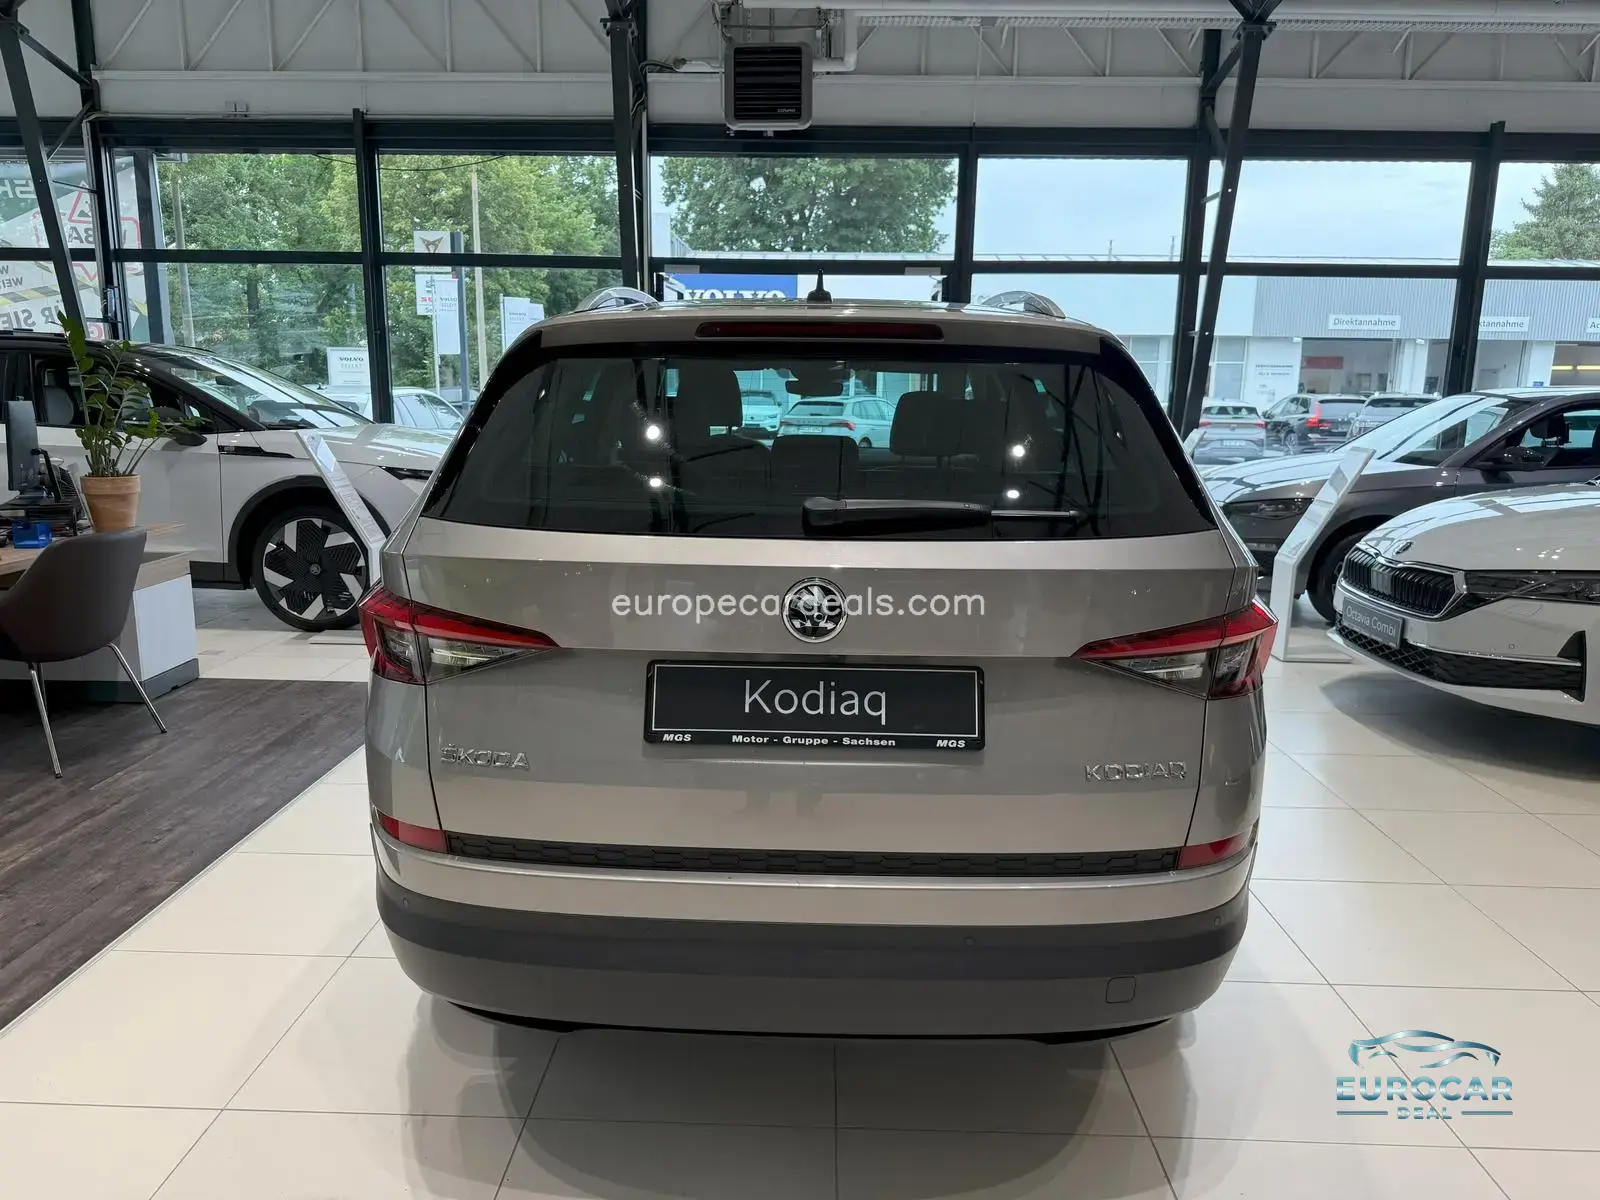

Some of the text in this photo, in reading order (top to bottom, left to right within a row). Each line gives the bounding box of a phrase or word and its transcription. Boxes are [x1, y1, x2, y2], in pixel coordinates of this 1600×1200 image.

[1333, 318, 1396, 327] Direktannahme
[1346, 604, 1397, 637] Octavia Combi
[743, 678, 887, 725] Kodiaq
[662, 733, 692, 742] MGS
[732, 734, 769, 743] Motor
[782, 736, 829, 746] Gruppe
[842, 737, 896, 747] Sachsen
[936, 739, 966, 748] MGS
